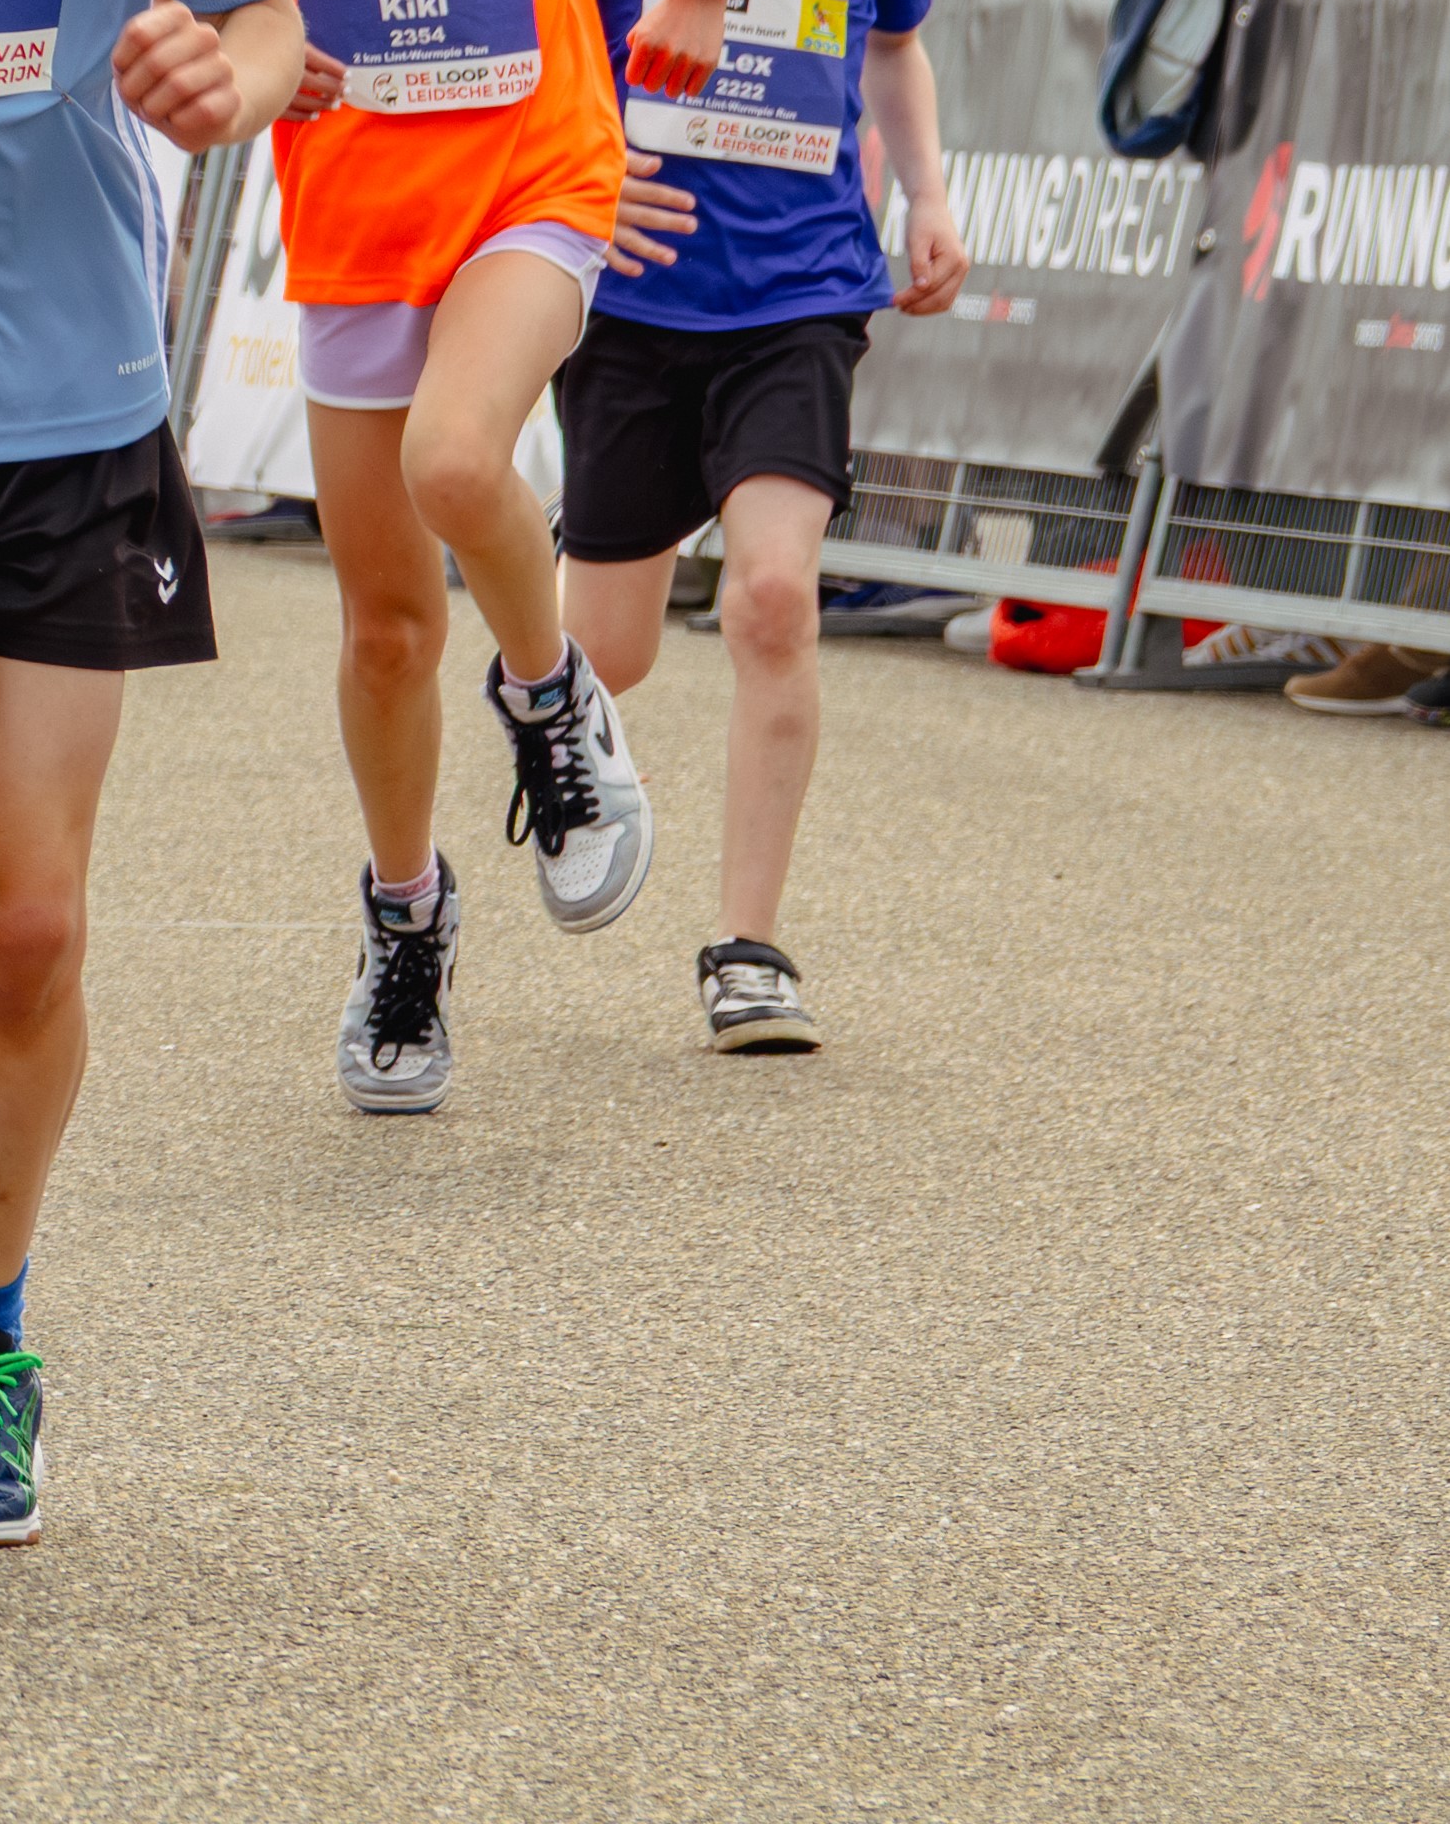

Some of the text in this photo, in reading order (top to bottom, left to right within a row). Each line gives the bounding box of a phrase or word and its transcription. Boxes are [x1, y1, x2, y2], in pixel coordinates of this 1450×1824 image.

[390, 26, 446, 47] 2354
[353, 45, 488, 64] 2 km Lint-Wurmpie Run
[718, 46, 774, 77] Lex
[405, 60, 534, 87] DE LOOP VAN
[408, 79, 535, 103] LEIDSCHE RIJN
[715, 78, 766, 102] 2222
[716, 121, 832, 149] DE LOOP VAN
[713, 136, 828, 164] LEIDSCHE RIJN
